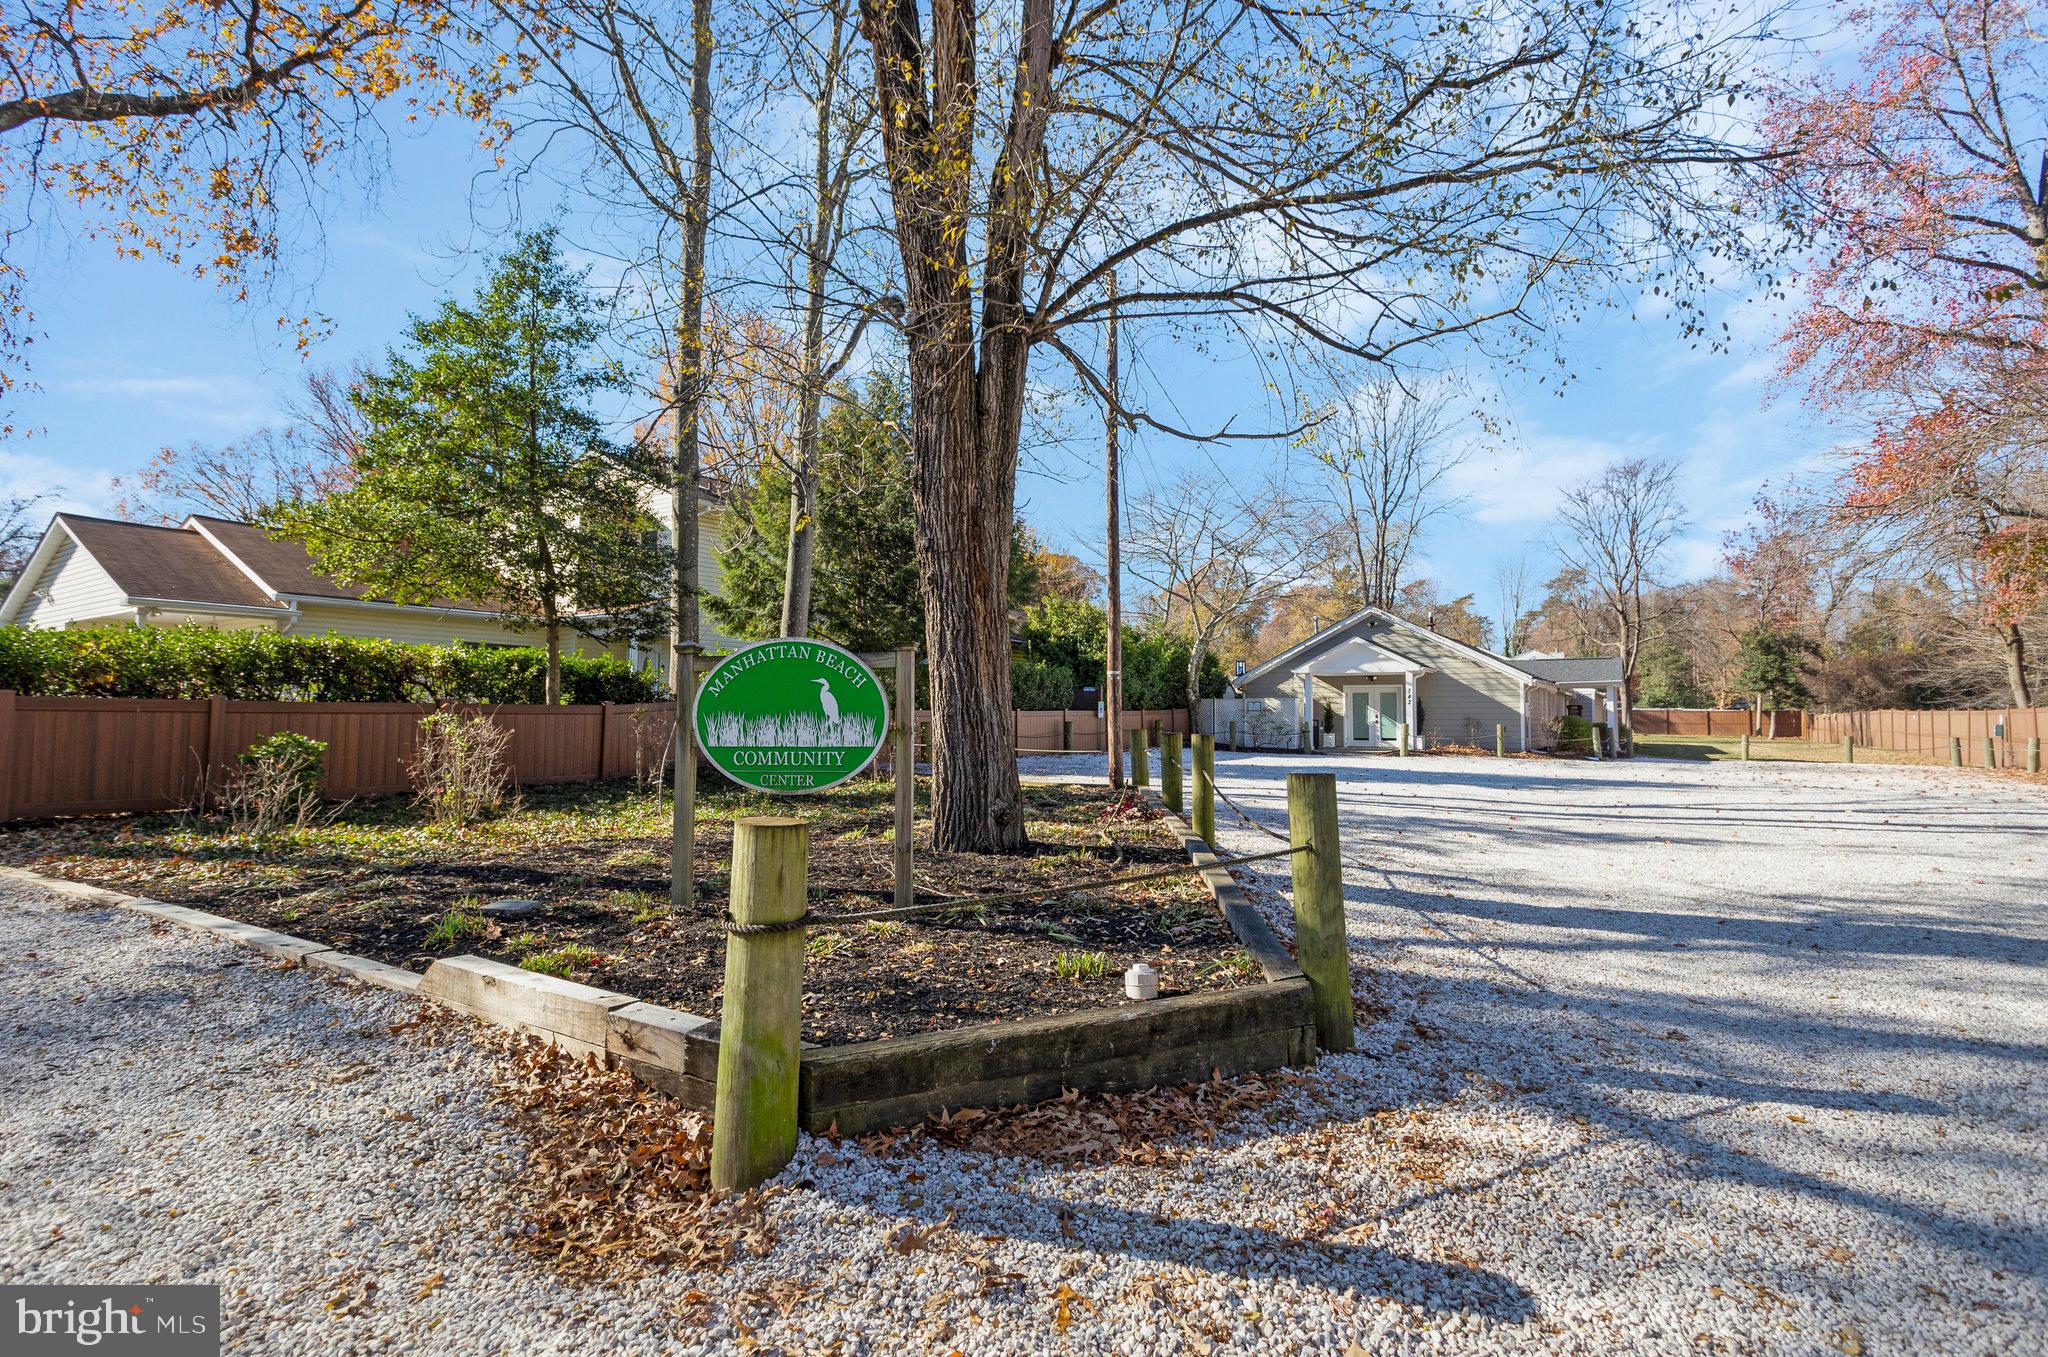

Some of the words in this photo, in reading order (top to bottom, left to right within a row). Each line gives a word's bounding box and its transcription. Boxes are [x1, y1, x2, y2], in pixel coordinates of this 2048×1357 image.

[708, 645, 811, 697] MANHATTAN
[815, 650, 867, 688] BEACH
[733, 751, 846, 766] COMMUNITY
[760, 774, 815, 786] CENTER
